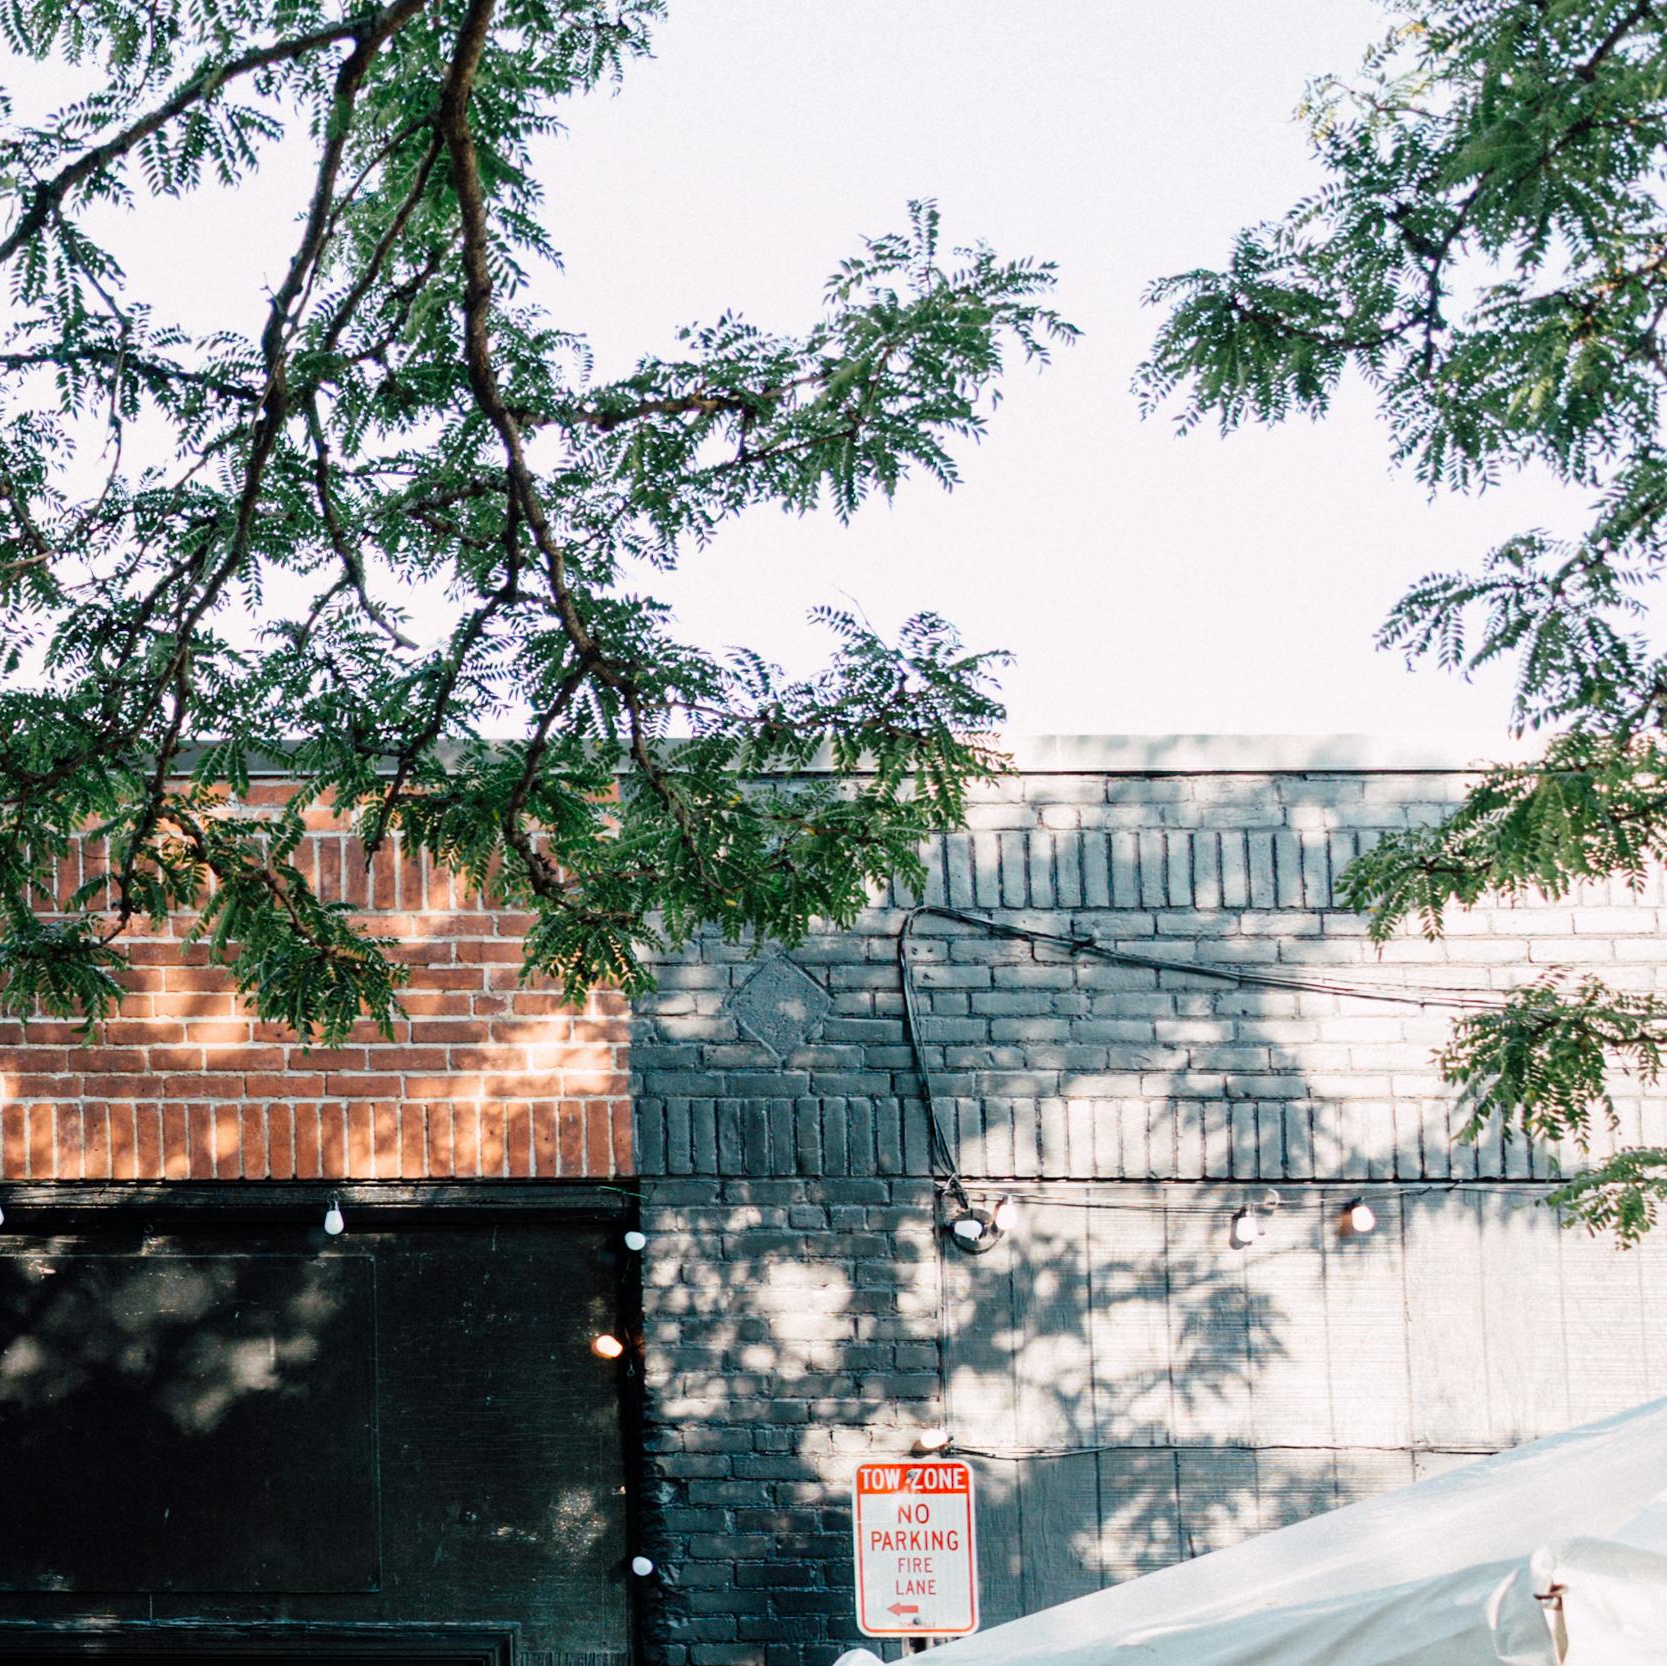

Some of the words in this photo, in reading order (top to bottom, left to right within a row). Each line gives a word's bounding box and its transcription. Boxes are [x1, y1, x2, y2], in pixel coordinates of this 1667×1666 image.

[860, 1468, 901, 1490] TOW
[908, 1467, 967, 1490] ZONE
[898, 1503, 929, 1524] NO
[871, 1530, 959, 1551] PARKING
[898, 1557, 932, 1573] FIRE
[896, 1579, 937, 1595] LANE
